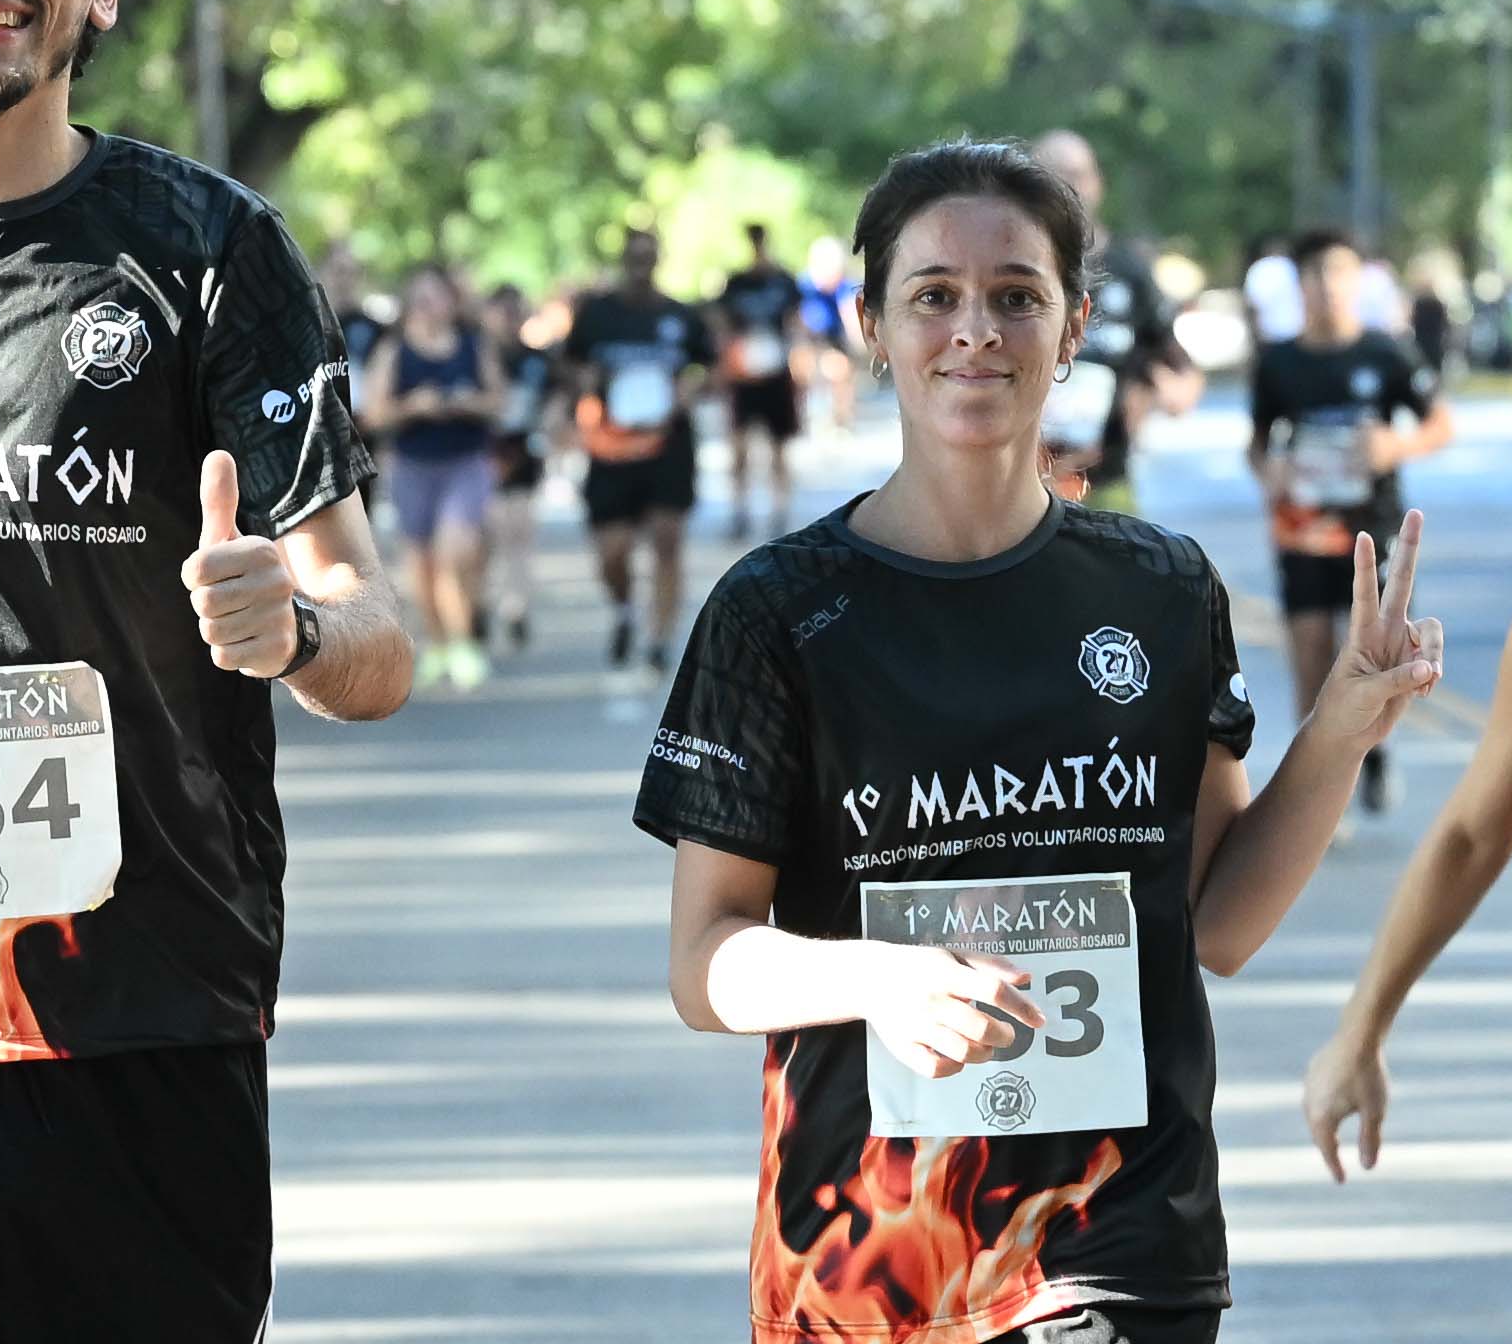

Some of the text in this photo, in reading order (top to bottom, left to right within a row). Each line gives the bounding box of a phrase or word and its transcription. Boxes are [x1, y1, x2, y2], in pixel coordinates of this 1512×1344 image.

[92, 327, 125, 355] 27
[86, 524, 147, 544] ROSARIO
[1102, 649, 1128, 674] 27
[51, 720, 100, 737] ROSARIO
[651, 743, 701, 770] OSARIO
[657, 727, 747, 771] CEJO MUNICPAL
[907, 735, 1157, 829] MARATÓN
[917, 832, 1007, 861] BOMBEROS
[1011, 826, 1116, 849] VOLUNTARIOS
[941, 889, 1097, 936] MARATÓN
[1007, 934, 1077, 953] VOLUNTARIOS
[1080, 932, 1126, 949] ROSARIO
[973, 969, 1104, 1061] 53
